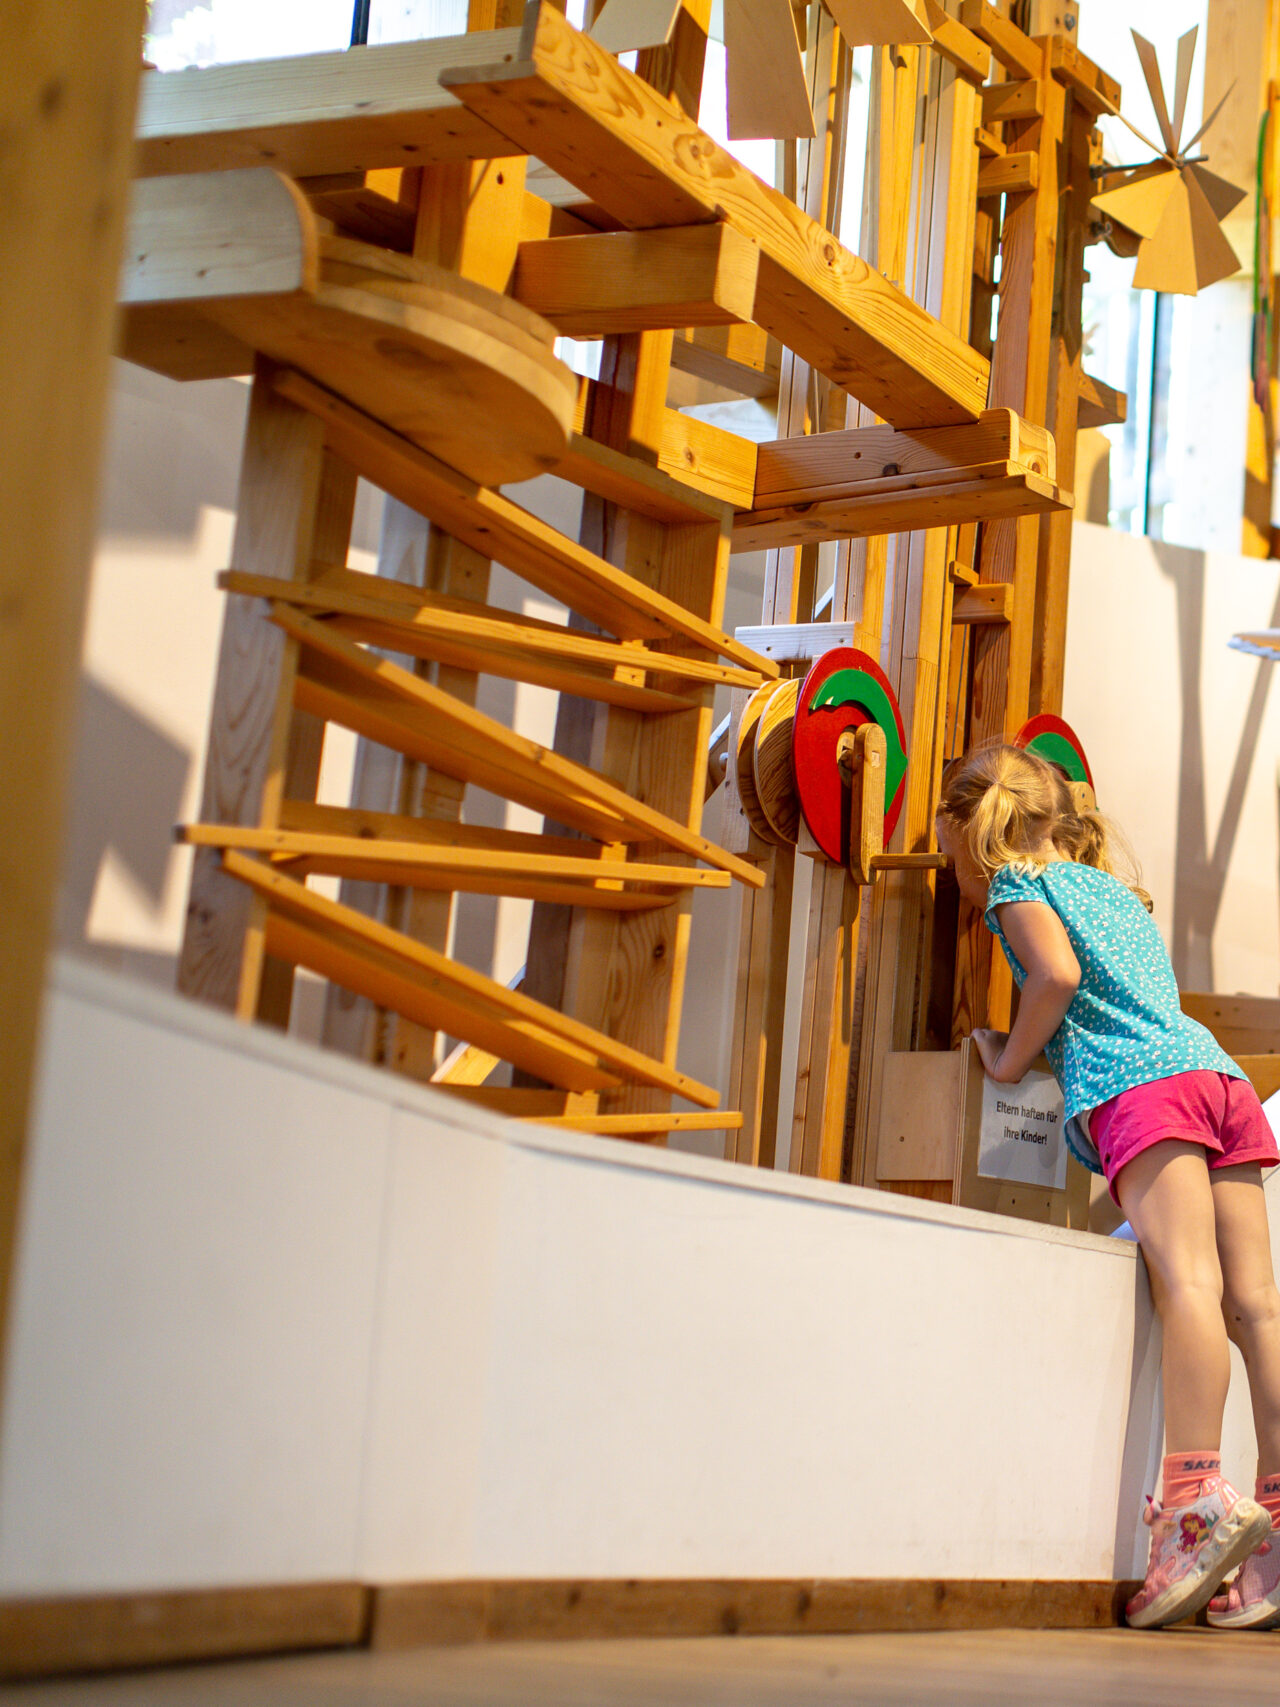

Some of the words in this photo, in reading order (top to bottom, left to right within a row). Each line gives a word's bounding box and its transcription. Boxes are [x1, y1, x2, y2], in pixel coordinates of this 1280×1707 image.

[996, 1101, 1019, 1115] Eltern
[1021, 1106, 1045, 1121] haften
[1046, 1110, 1058, 1123] für
[1004, 1126, 1020, 1140] ihre
[1021, 1129, 1047, 1145] Kinder!
